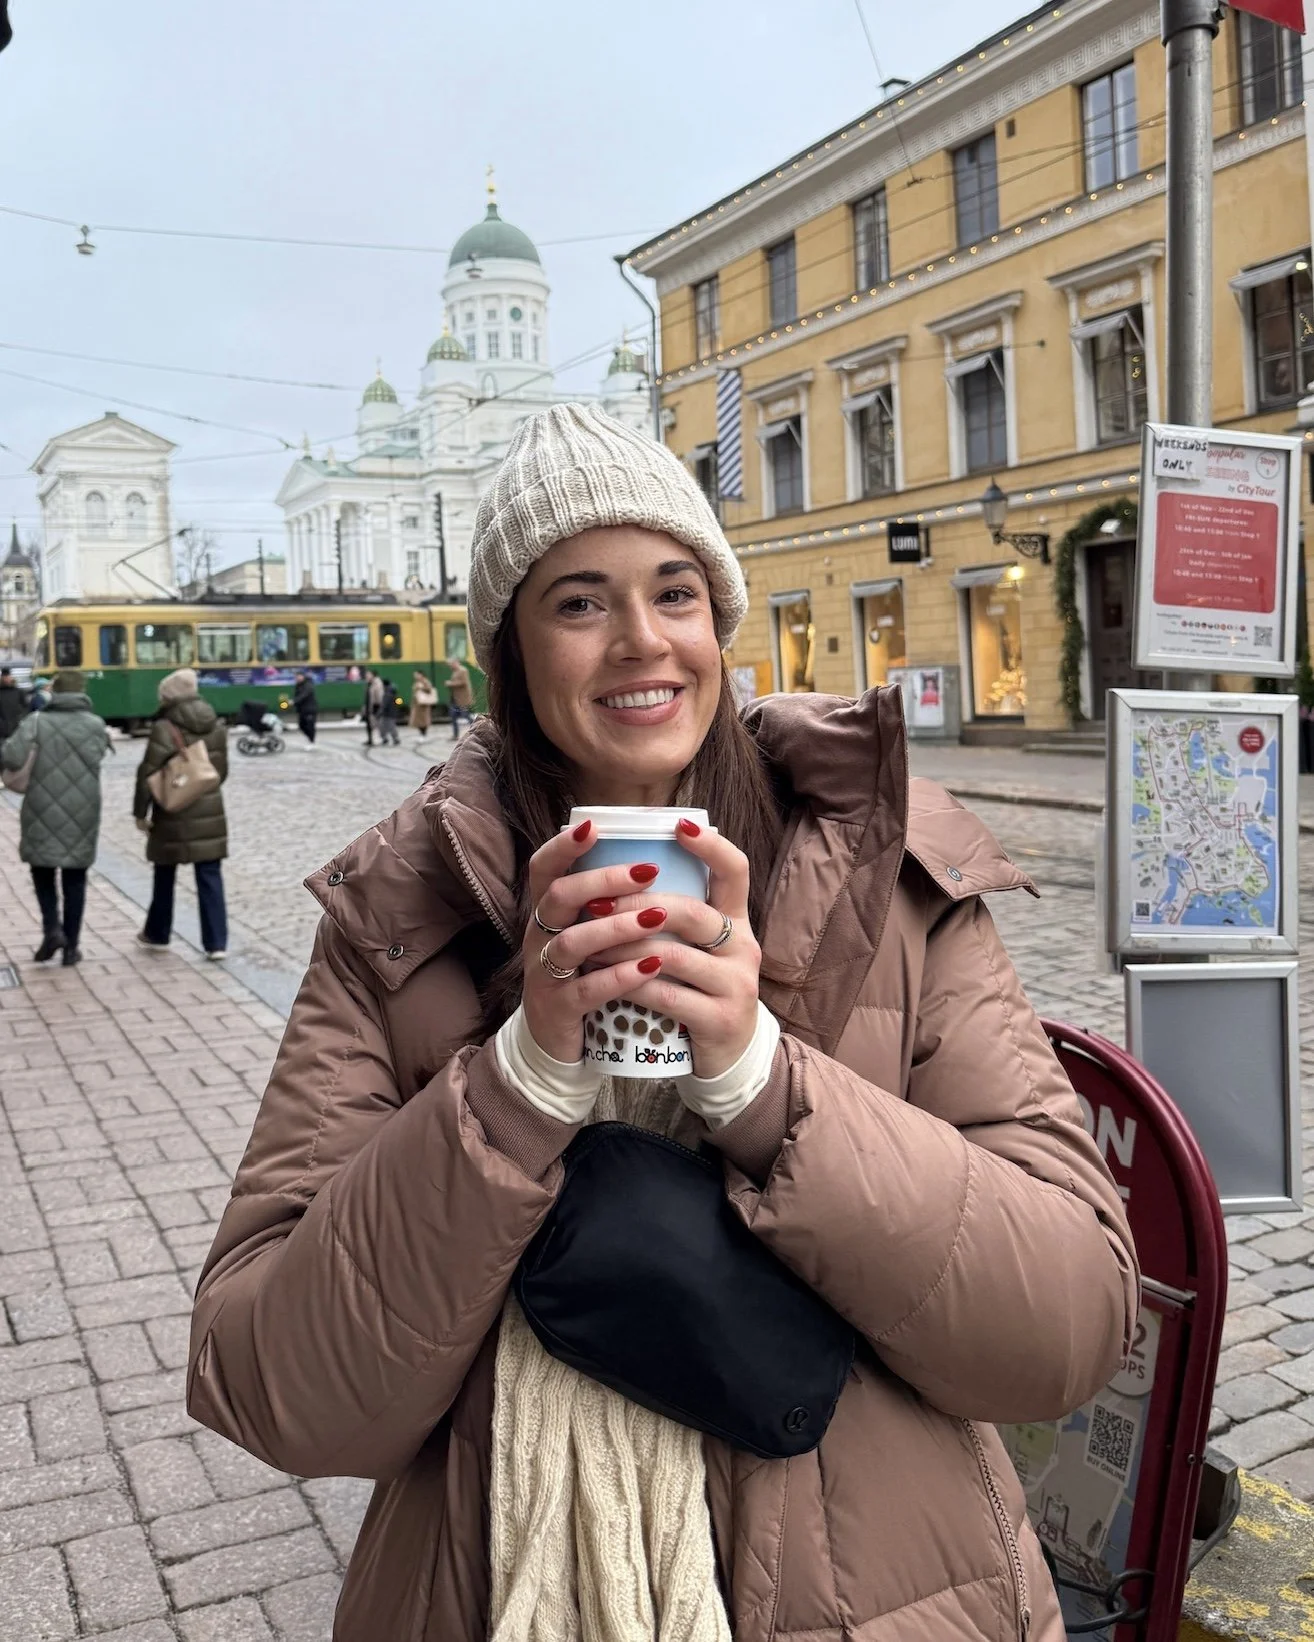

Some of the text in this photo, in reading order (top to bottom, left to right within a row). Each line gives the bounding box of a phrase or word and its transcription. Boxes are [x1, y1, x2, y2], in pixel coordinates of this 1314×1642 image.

[1162, 459, 1193, 472] ONLY
[1237, 484, 1276, 496] CityTour
[635, 1046, 690, 1064] bonbon
[1086, 1455, 1126, 1482] BUY ONLINE
